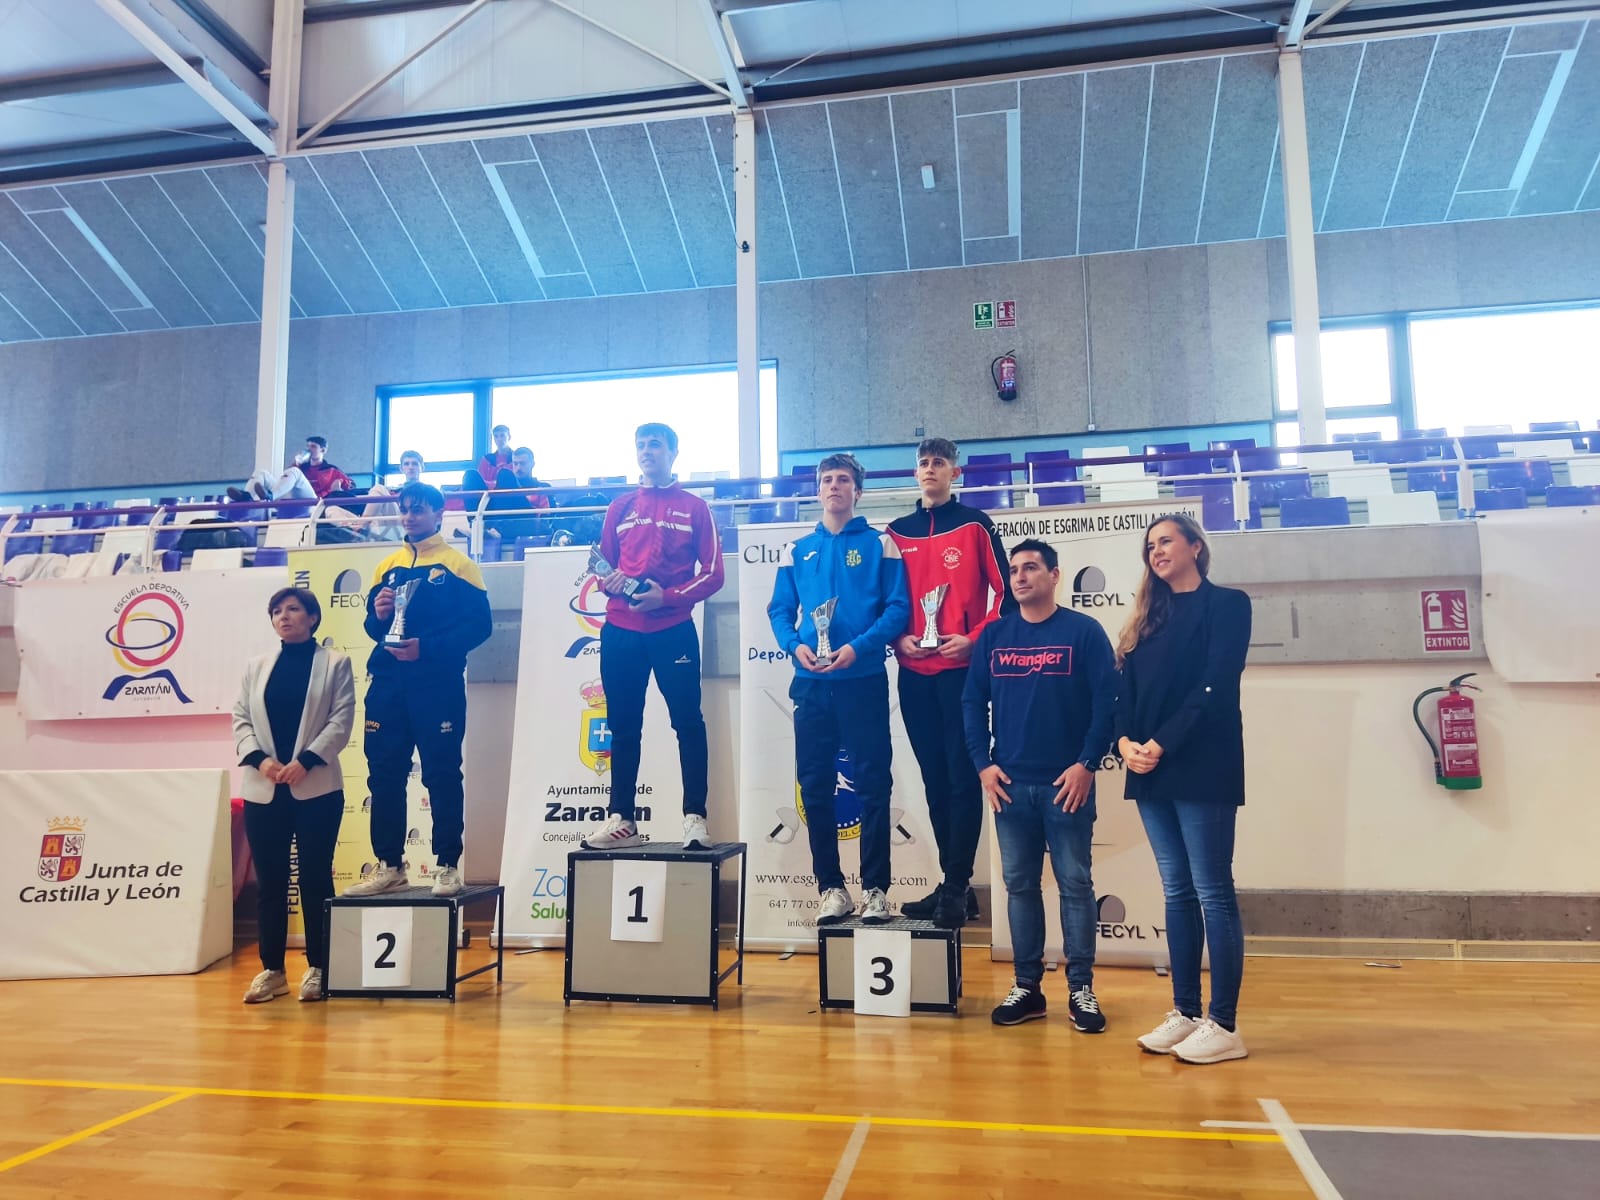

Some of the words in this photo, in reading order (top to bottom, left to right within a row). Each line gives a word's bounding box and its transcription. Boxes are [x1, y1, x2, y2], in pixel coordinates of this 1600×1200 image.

[997, 517, 1036, 537] ERACIÓN
[1039, 520, 1051, 535] DE
[1054, 517, 1095, 534] ESGRIMA
[1100, 516, 1110, 531] DE
[113, 584, 147, 614] ESCUELA
[149, 583, 190, 610] DEPORTIVA
[330, 594, 368, 608] FECY
[1071, 593, 1125, 608] FECYL
[1426, 636, 1469, 649] EXTINTOR
[748, 647, 792, 664] Depor
[998, 651, 1063, 672] Wrangler
[124, 682, 171, 696] ZARATÁN
[547, 785, 611, 798] Ayuntamie
[637, 784, 653, 795] de
[544, 802, 652, 822] Zaran
[85, 863, 149, 879] Junta
[155, 861, 183, 877] de
[19, 885, 100, 903] Castilla
[104, 888, 119, 906] y
[126, 883, 180, 900] León
[627, 886, 648, 923] 1
[769, 900, 788, 909] 647
[791, 900, 804, 909] 77
[806, 900, 820, 910] 05
[374, 932, 396, 968] 2
[869, 956, 895, 996] 3
